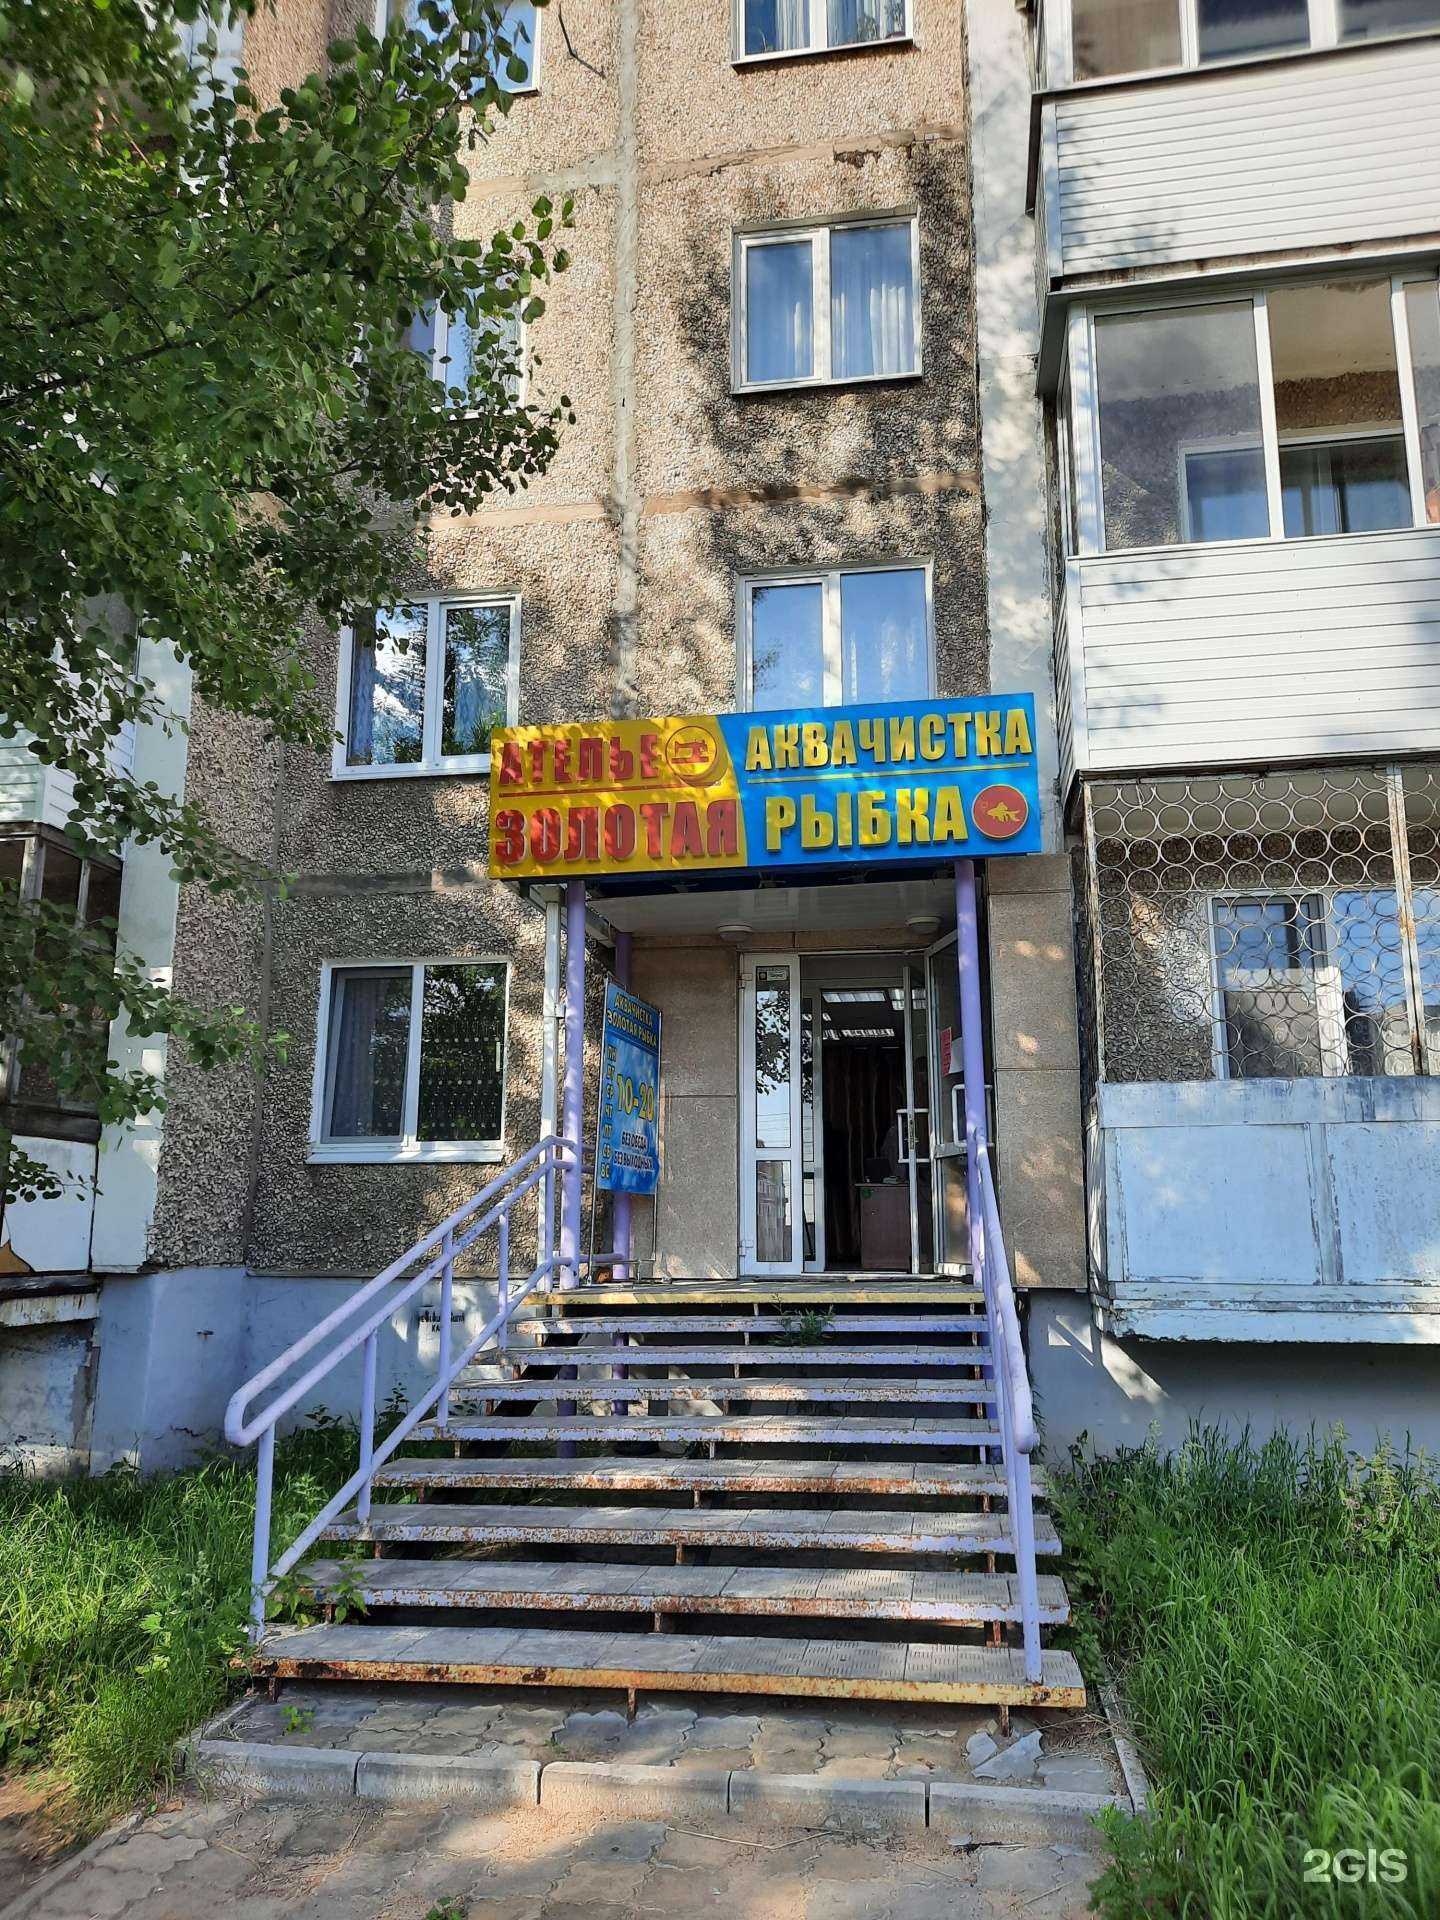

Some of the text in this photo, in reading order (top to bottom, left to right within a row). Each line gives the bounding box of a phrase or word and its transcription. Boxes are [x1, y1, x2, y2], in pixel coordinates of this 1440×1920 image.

[498, 708, 1033, 786] АТЕЛЬЕ АКВАЧИСТКА
[495, 784, 970, 866] ЗОЛОТАЯ РЫБКА
[614, 991, 653, 1028] АКВАЧИСТКА
[607, 1009, 657, 1047] ЗОЛОТАЯ РЫБКА
[607, 1045, 617, 1062] ПН
[616, 1073, 655, 1122] 10-20
[605, 1103, 613, 1120] ЧТ
[603, 1123, 612, 1139] ПТ
[621, 1131, 647, 1149] БЕЗ ОБЕДА
[613, 1150, 653, 1170] БЕЗ ВЫХОДНЫХ
[600, 1162, 610, 1179] ВС
